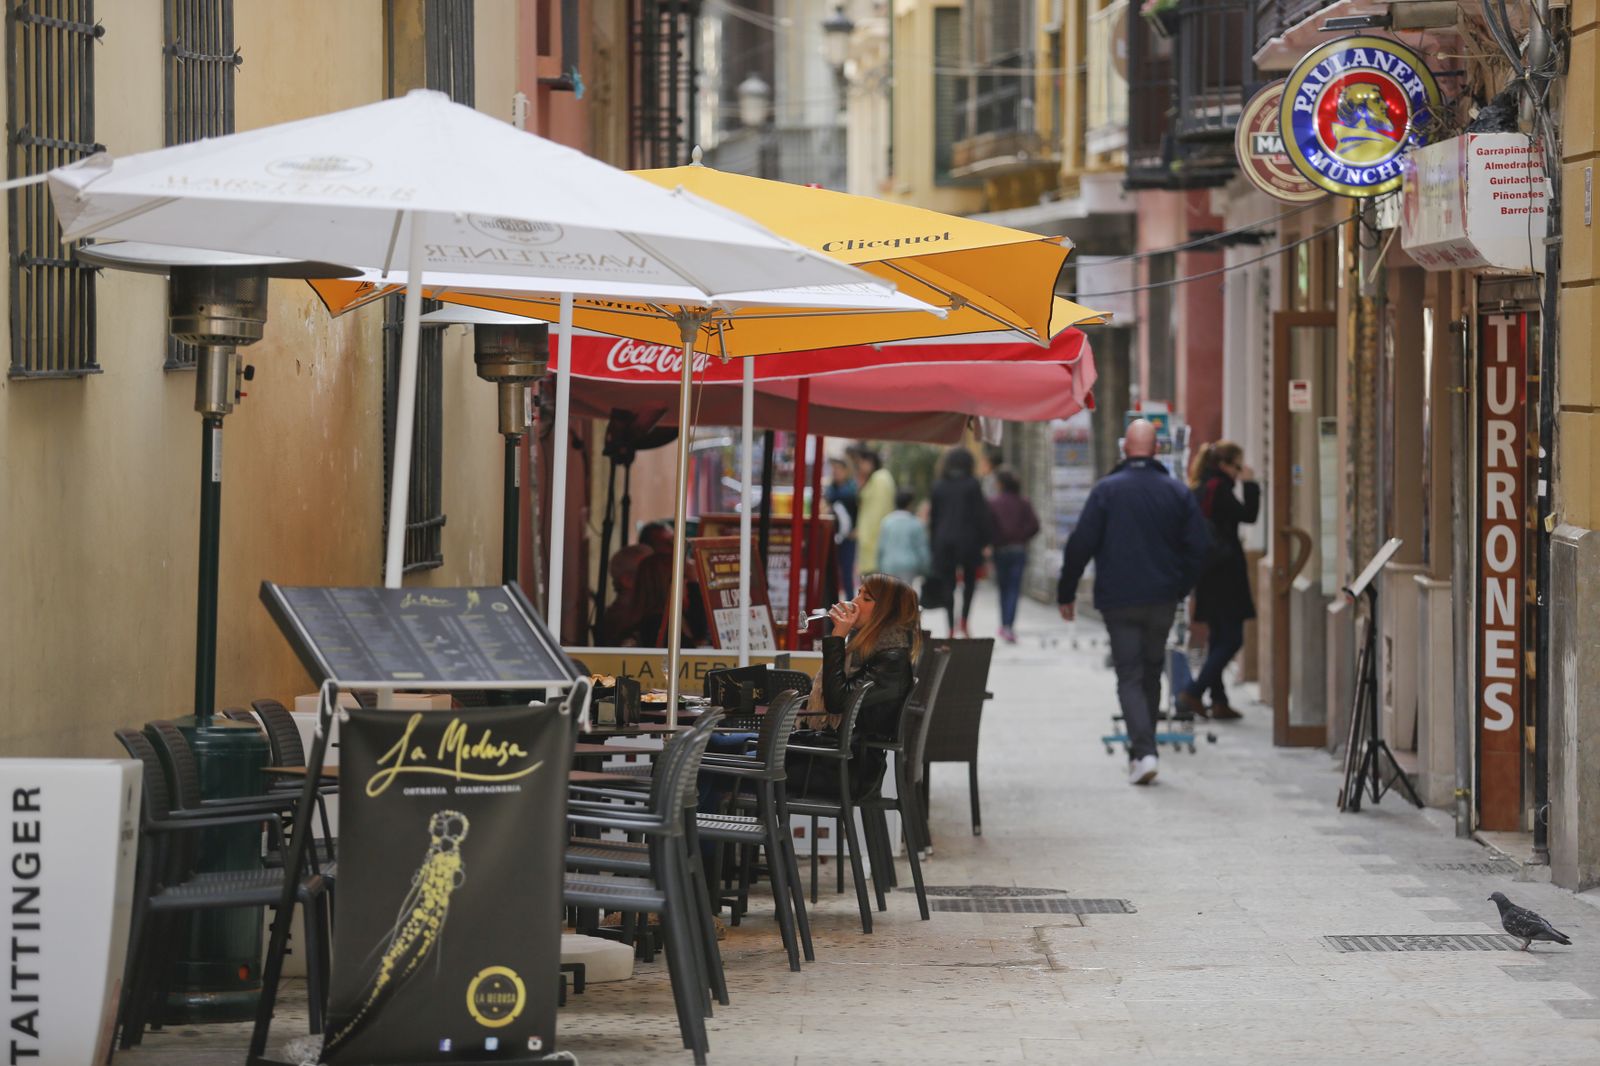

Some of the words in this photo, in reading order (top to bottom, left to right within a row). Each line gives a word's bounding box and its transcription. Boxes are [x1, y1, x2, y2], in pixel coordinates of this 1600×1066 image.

[1294, 48, 1425, 114] PAULANER
[1489, 175, 1544, 185] Guirlaches
[1492, 190, 1544, 200] Piñonates
[1500, 206, 1544, 215] Barretas
[821, 230, 955, 253] Clicquot
[1482, 314, 1518, 733] TURRONES
[366, 702, 426, 797] La
[438, 717, 528, 782] Medusa
[10, 786, 41, 1066] TAITTINGER
